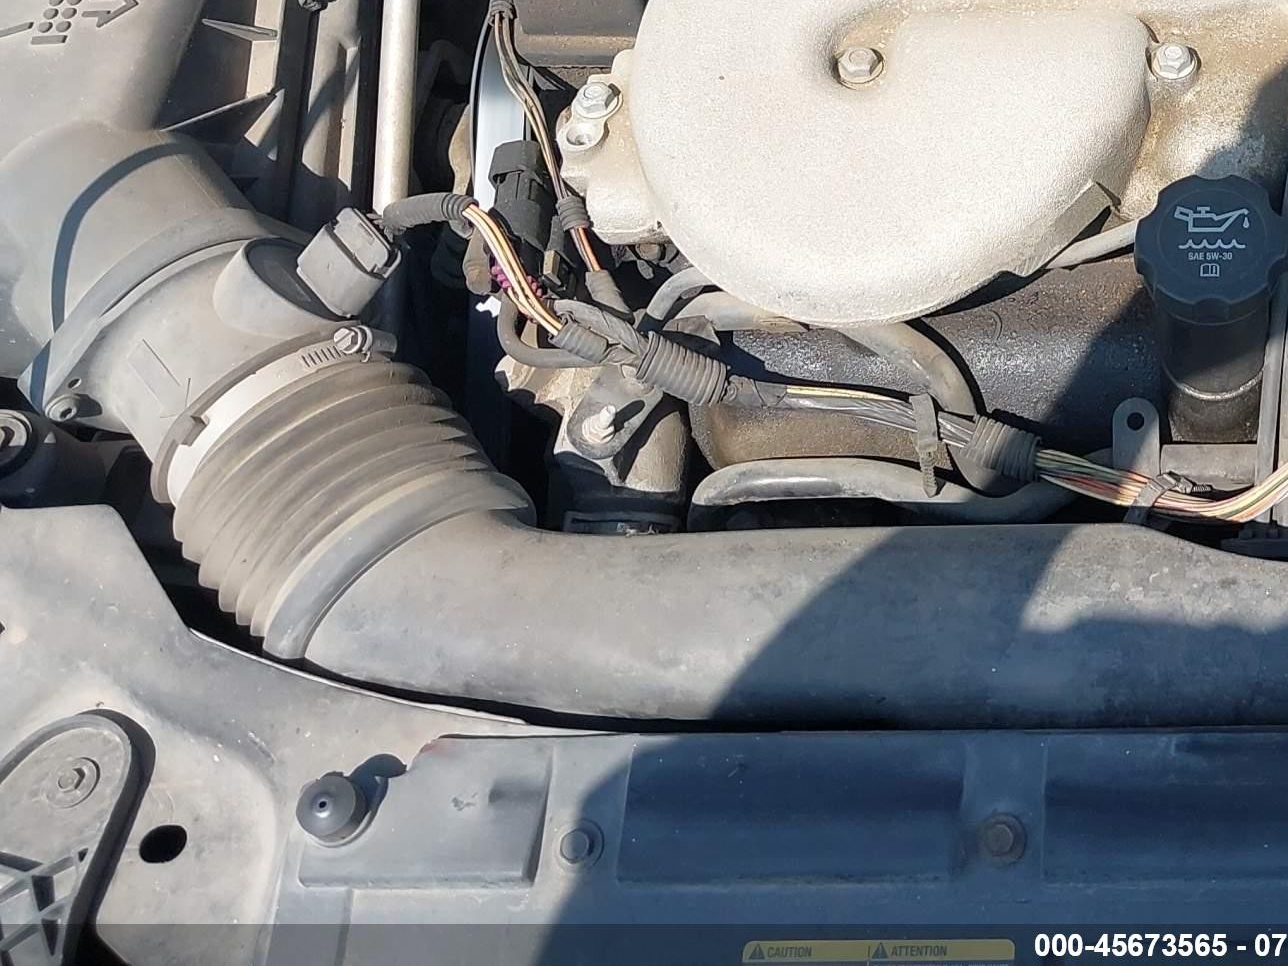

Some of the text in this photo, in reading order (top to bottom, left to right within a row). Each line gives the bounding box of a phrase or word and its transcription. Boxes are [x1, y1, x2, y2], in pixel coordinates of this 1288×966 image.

[1188, 252, 1233, 260] SAE 5W-30
[767, 945, 812, 958] CAUTION
[890, 945, 948, 957] ATTENTION
